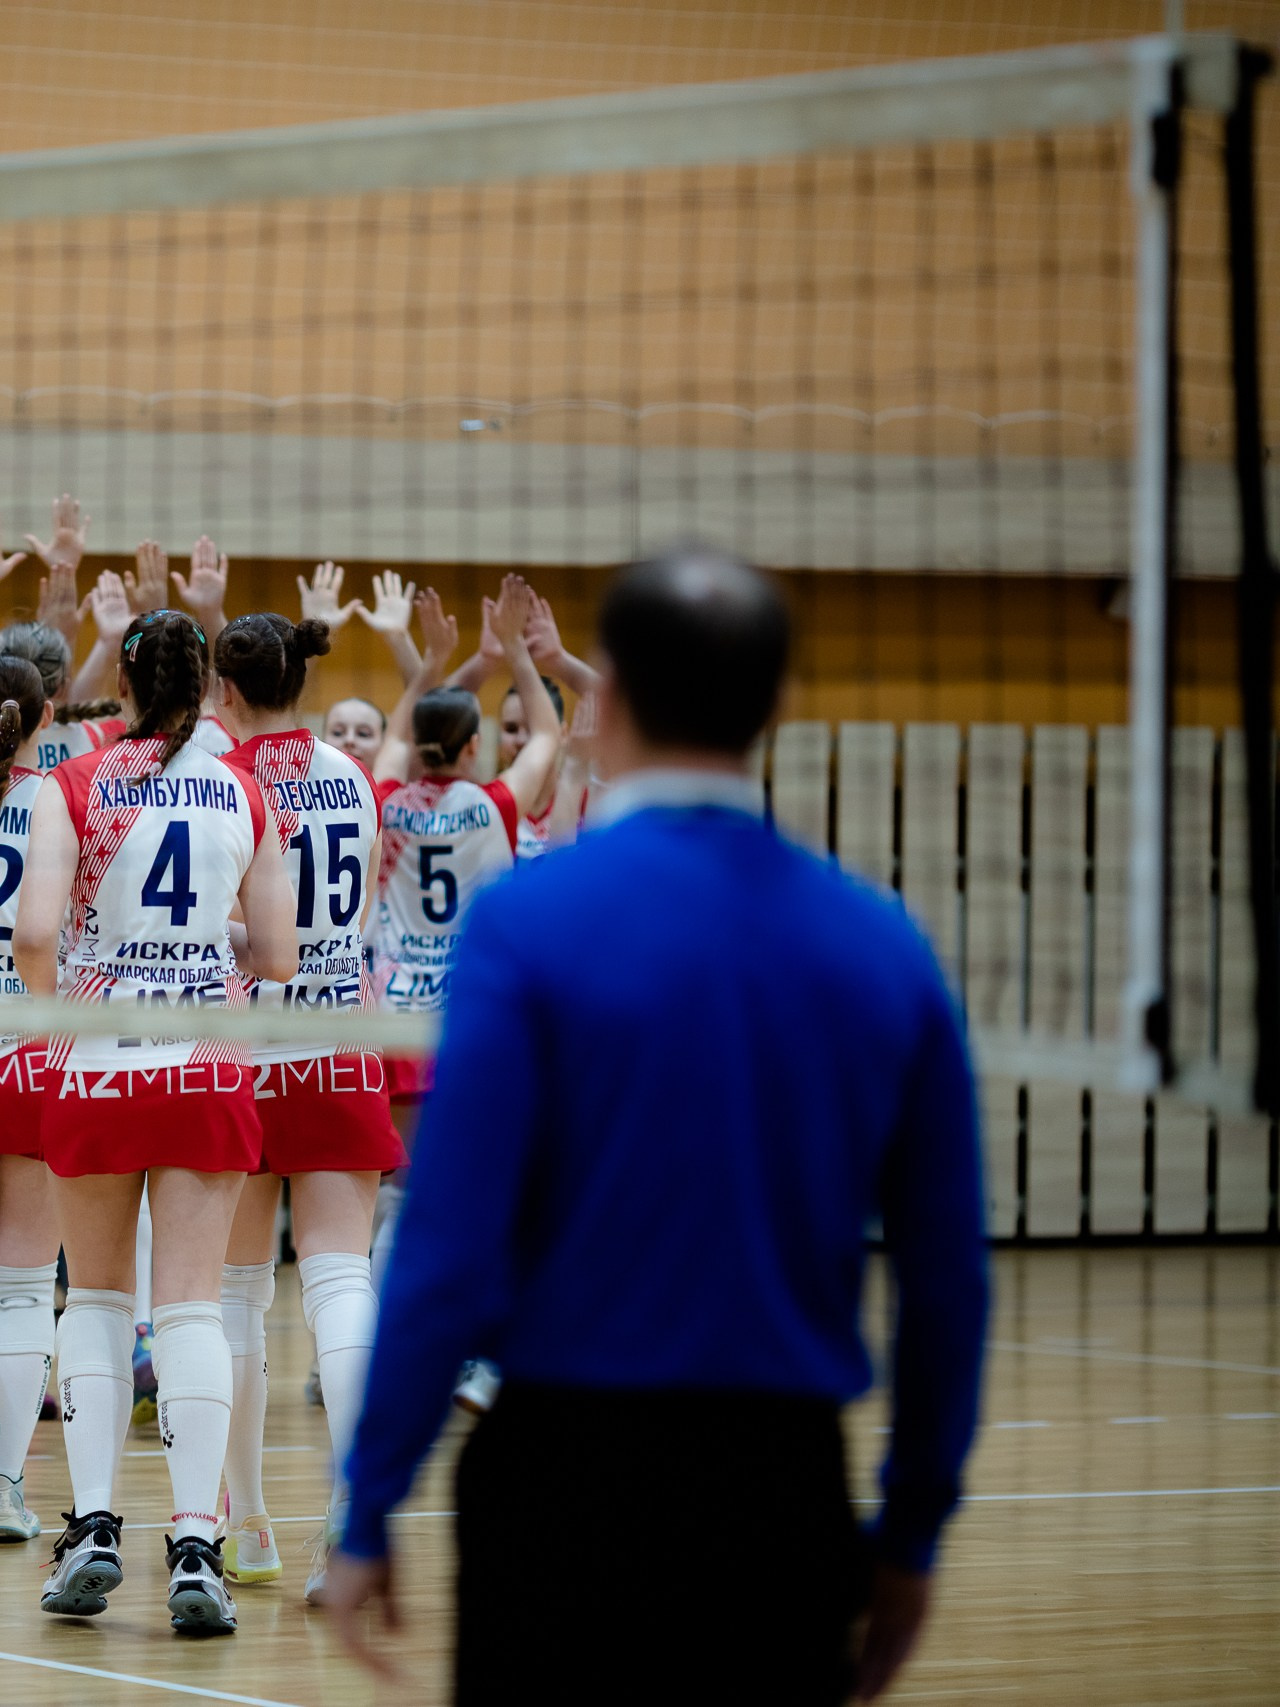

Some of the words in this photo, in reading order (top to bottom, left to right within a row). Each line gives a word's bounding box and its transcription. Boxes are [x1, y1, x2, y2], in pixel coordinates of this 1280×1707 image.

[97, 777, 238, 814] ХАБИБУЛИНА
[141, 821, 197, 926] 4
[289, 823, 361, 928] 15
[419, 845, 458, 924] 5
[116, 942, 220, 961] ИСКРА
[98, 962, 175, 983] САМАРСКАЯ
[58, 1063, 242, 1099] A2MED
